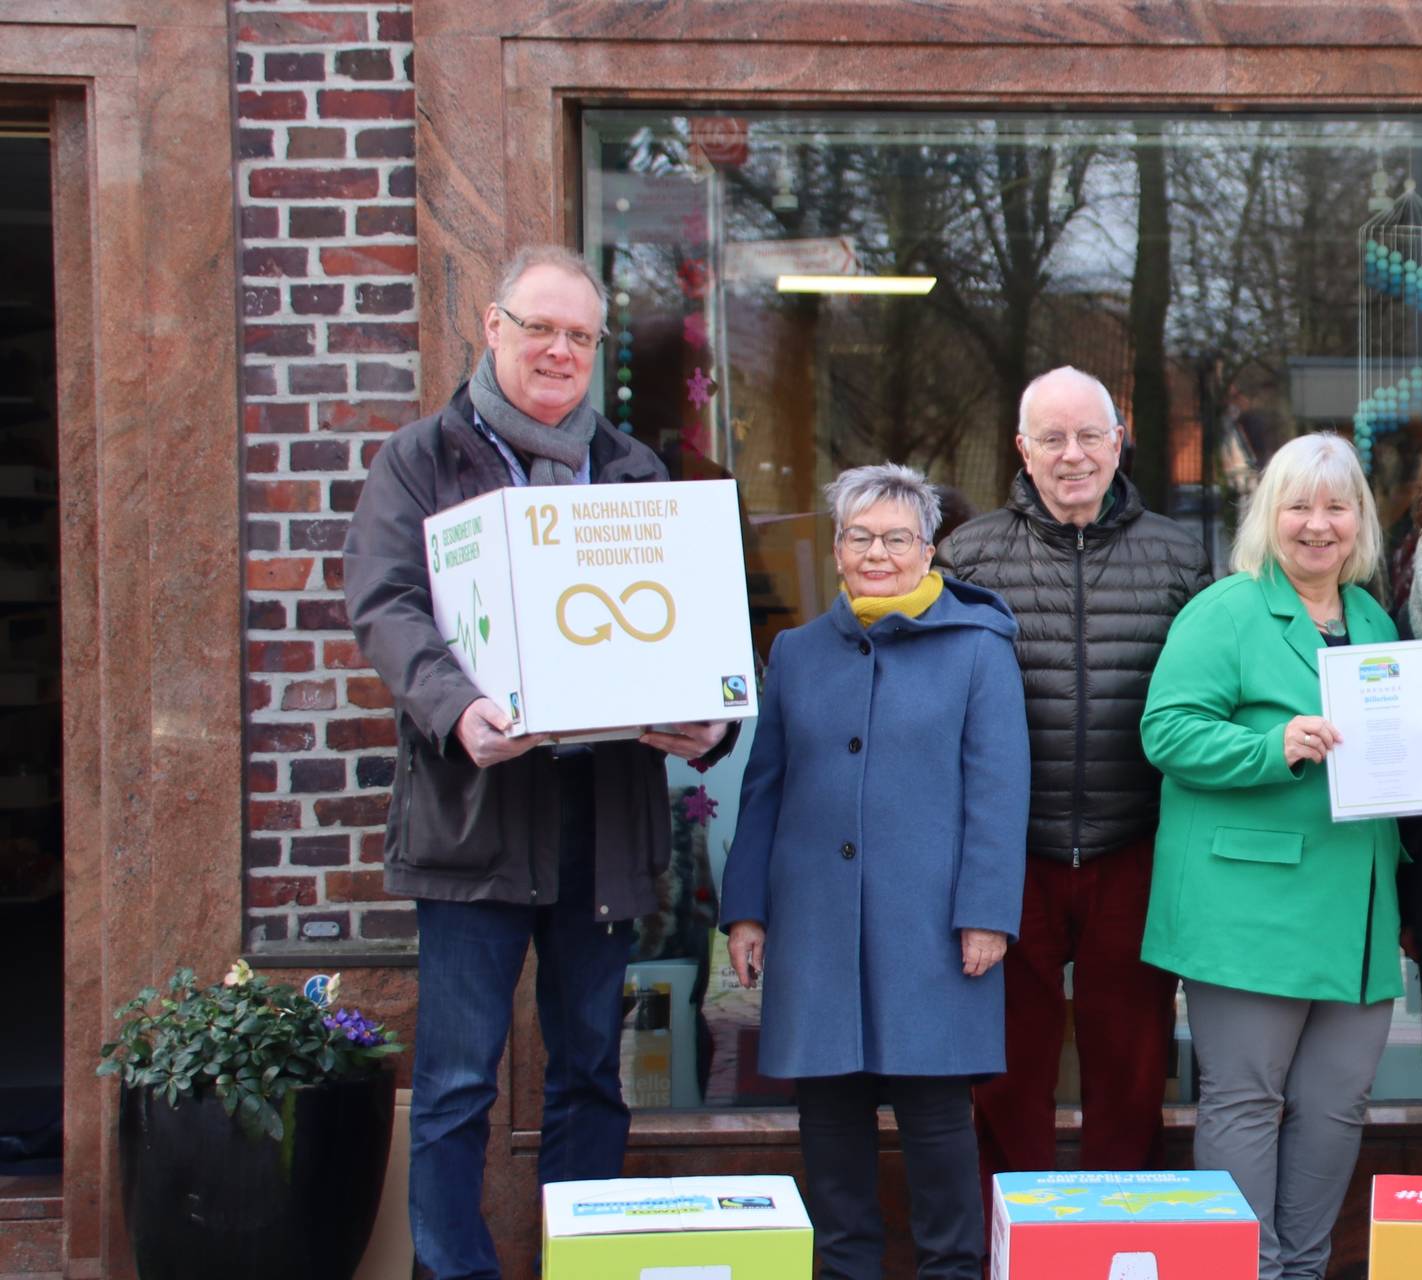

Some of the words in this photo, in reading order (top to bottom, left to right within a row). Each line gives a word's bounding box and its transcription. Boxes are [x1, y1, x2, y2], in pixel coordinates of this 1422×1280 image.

[572, 499, 679, 521] NACHHALTIGE/R
[525, 503, 561, 546] 12
[574, 524, 632, 544] KONSUM
[635, 522, 663, 542] UND
[431, 533, 441, 573] 3
[576, 546, 664, 568] PRODUKTION
